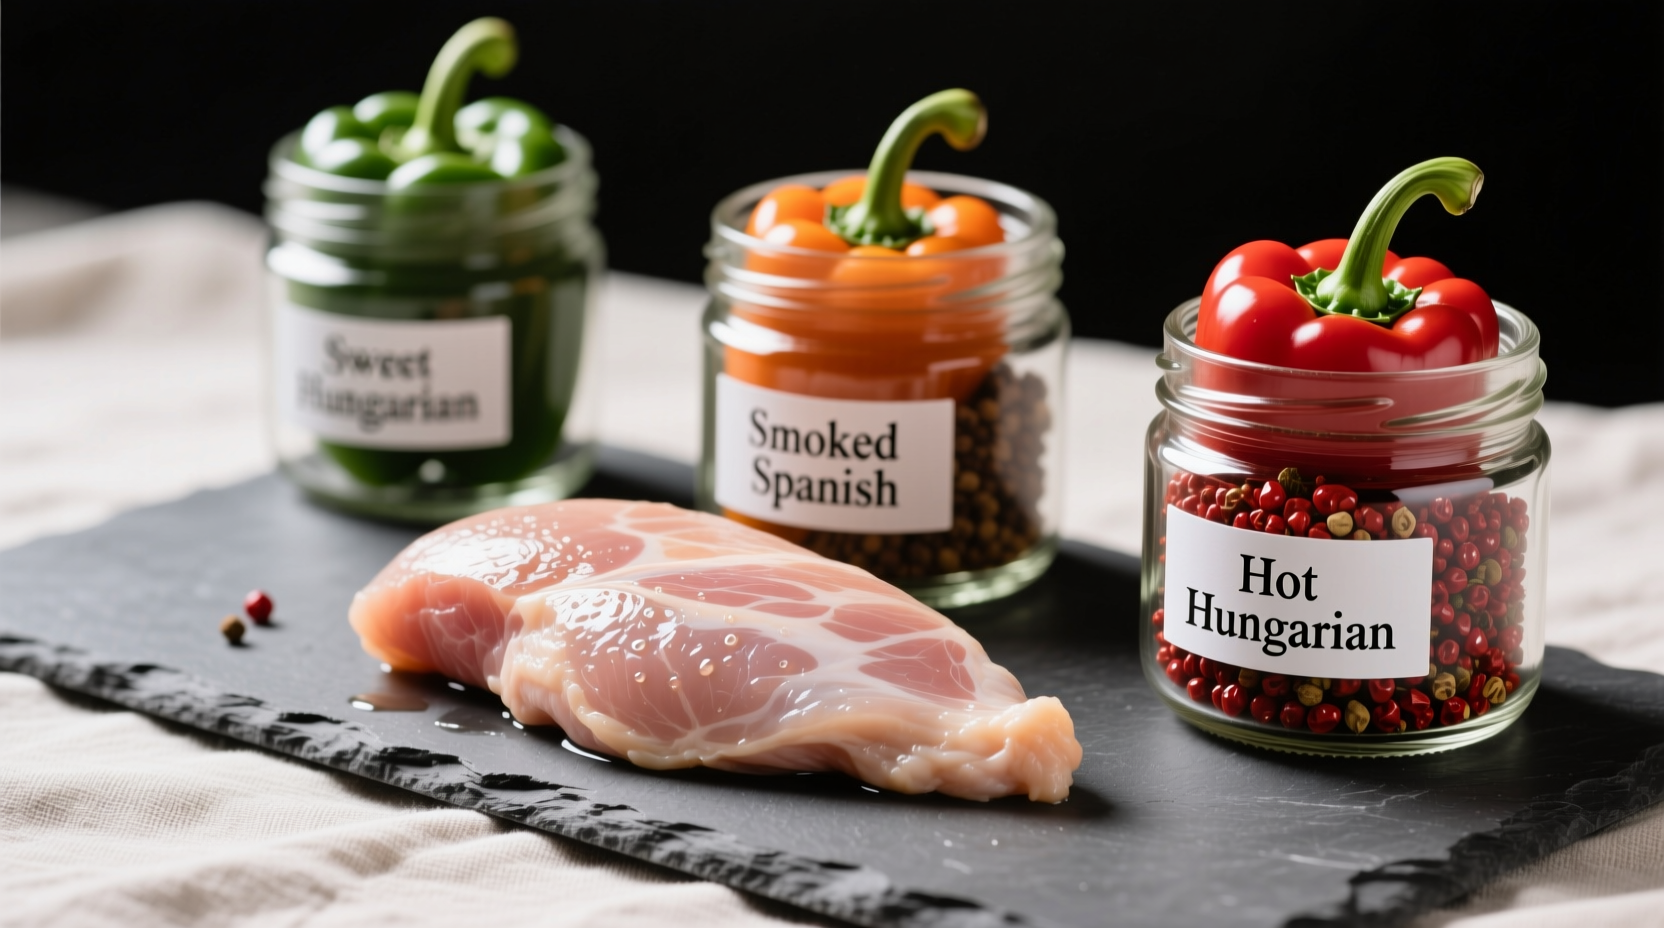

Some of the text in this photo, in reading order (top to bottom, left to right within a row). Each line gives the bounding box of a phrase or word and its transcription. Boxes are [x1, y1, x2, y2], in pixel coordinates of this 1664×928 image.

[322, 332, 431, 379] Sweet
[297, 371, 480, 434] Hungarian
[750, 408, 899, 461] Smoked
[752, 456, 899, 510] Spanish
[1239, 553, 1318, 601] Hot
[1185, 586, 1396, 657] Hungarian
